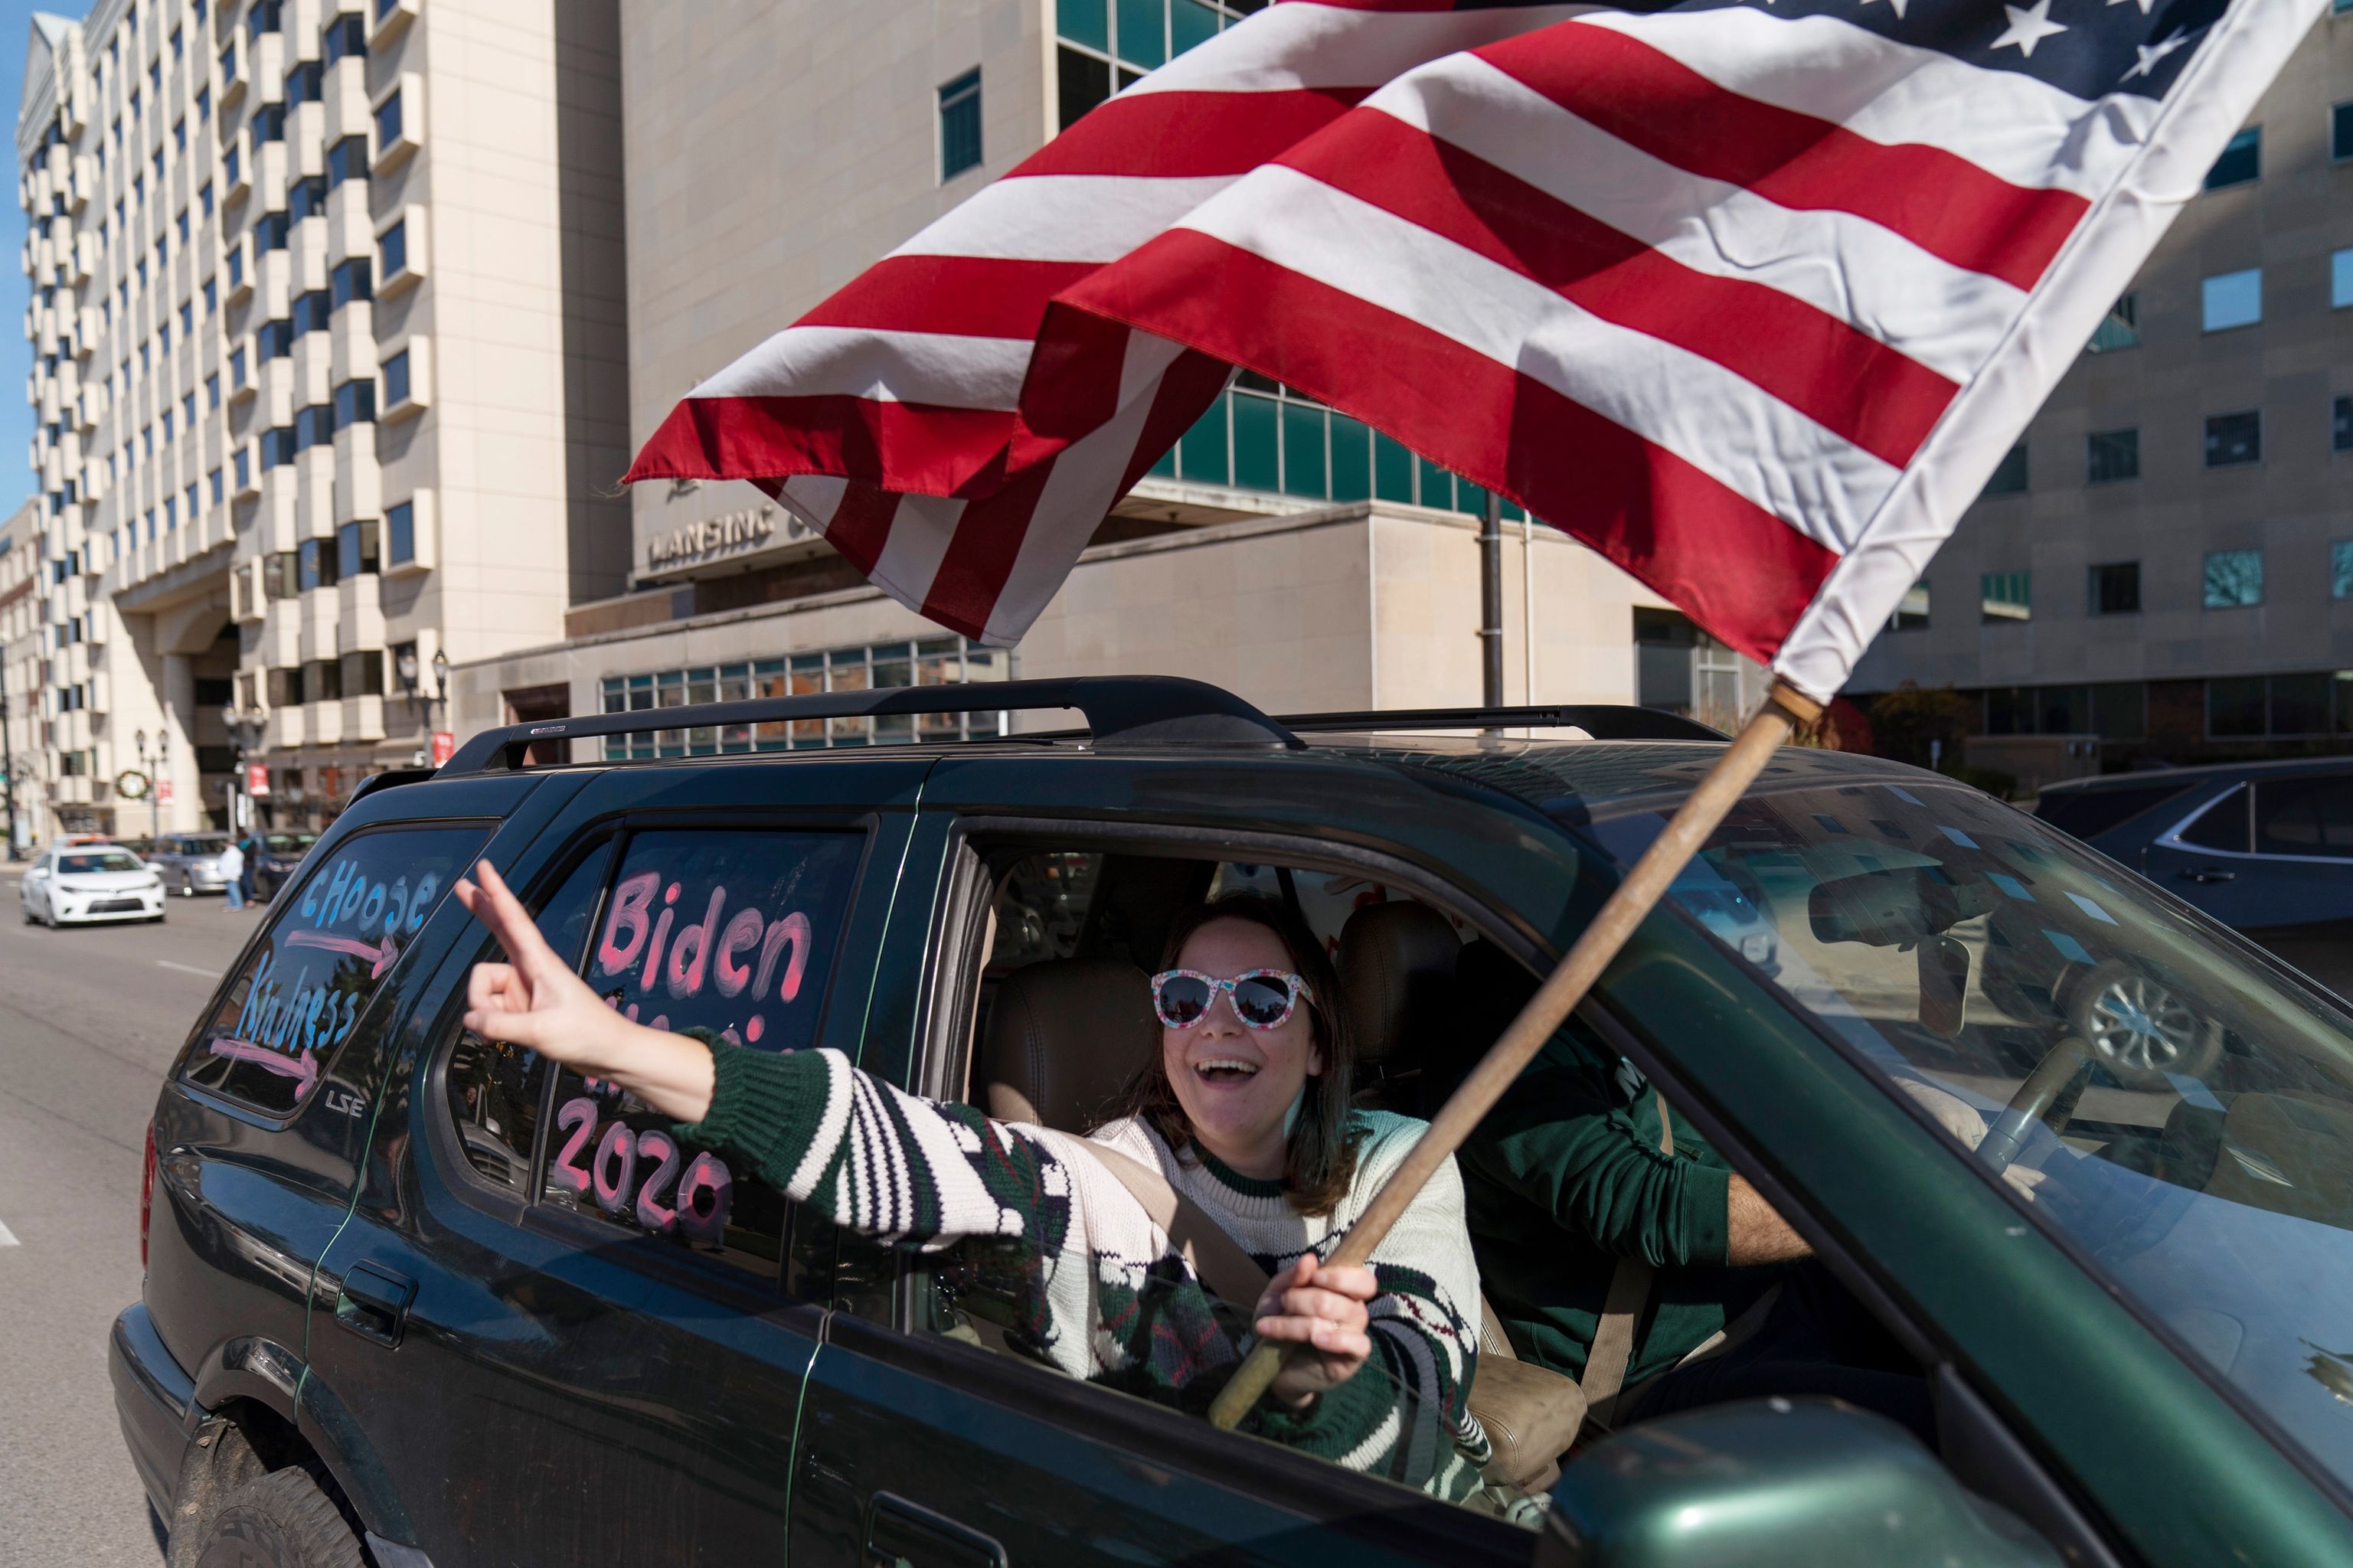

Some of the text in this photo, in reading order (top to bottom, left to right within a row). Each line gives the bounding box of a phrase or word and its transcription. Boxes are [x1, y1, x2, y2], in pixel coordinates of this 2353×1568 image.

[650, 502, 776, 561] LANSING
[599, 871, 812, 1004] Biden
[234, 950, 359, 1054] Kindness
[325, 1089, 367, 1119] LSE
[554, 1097, 733, 1233] 2020
